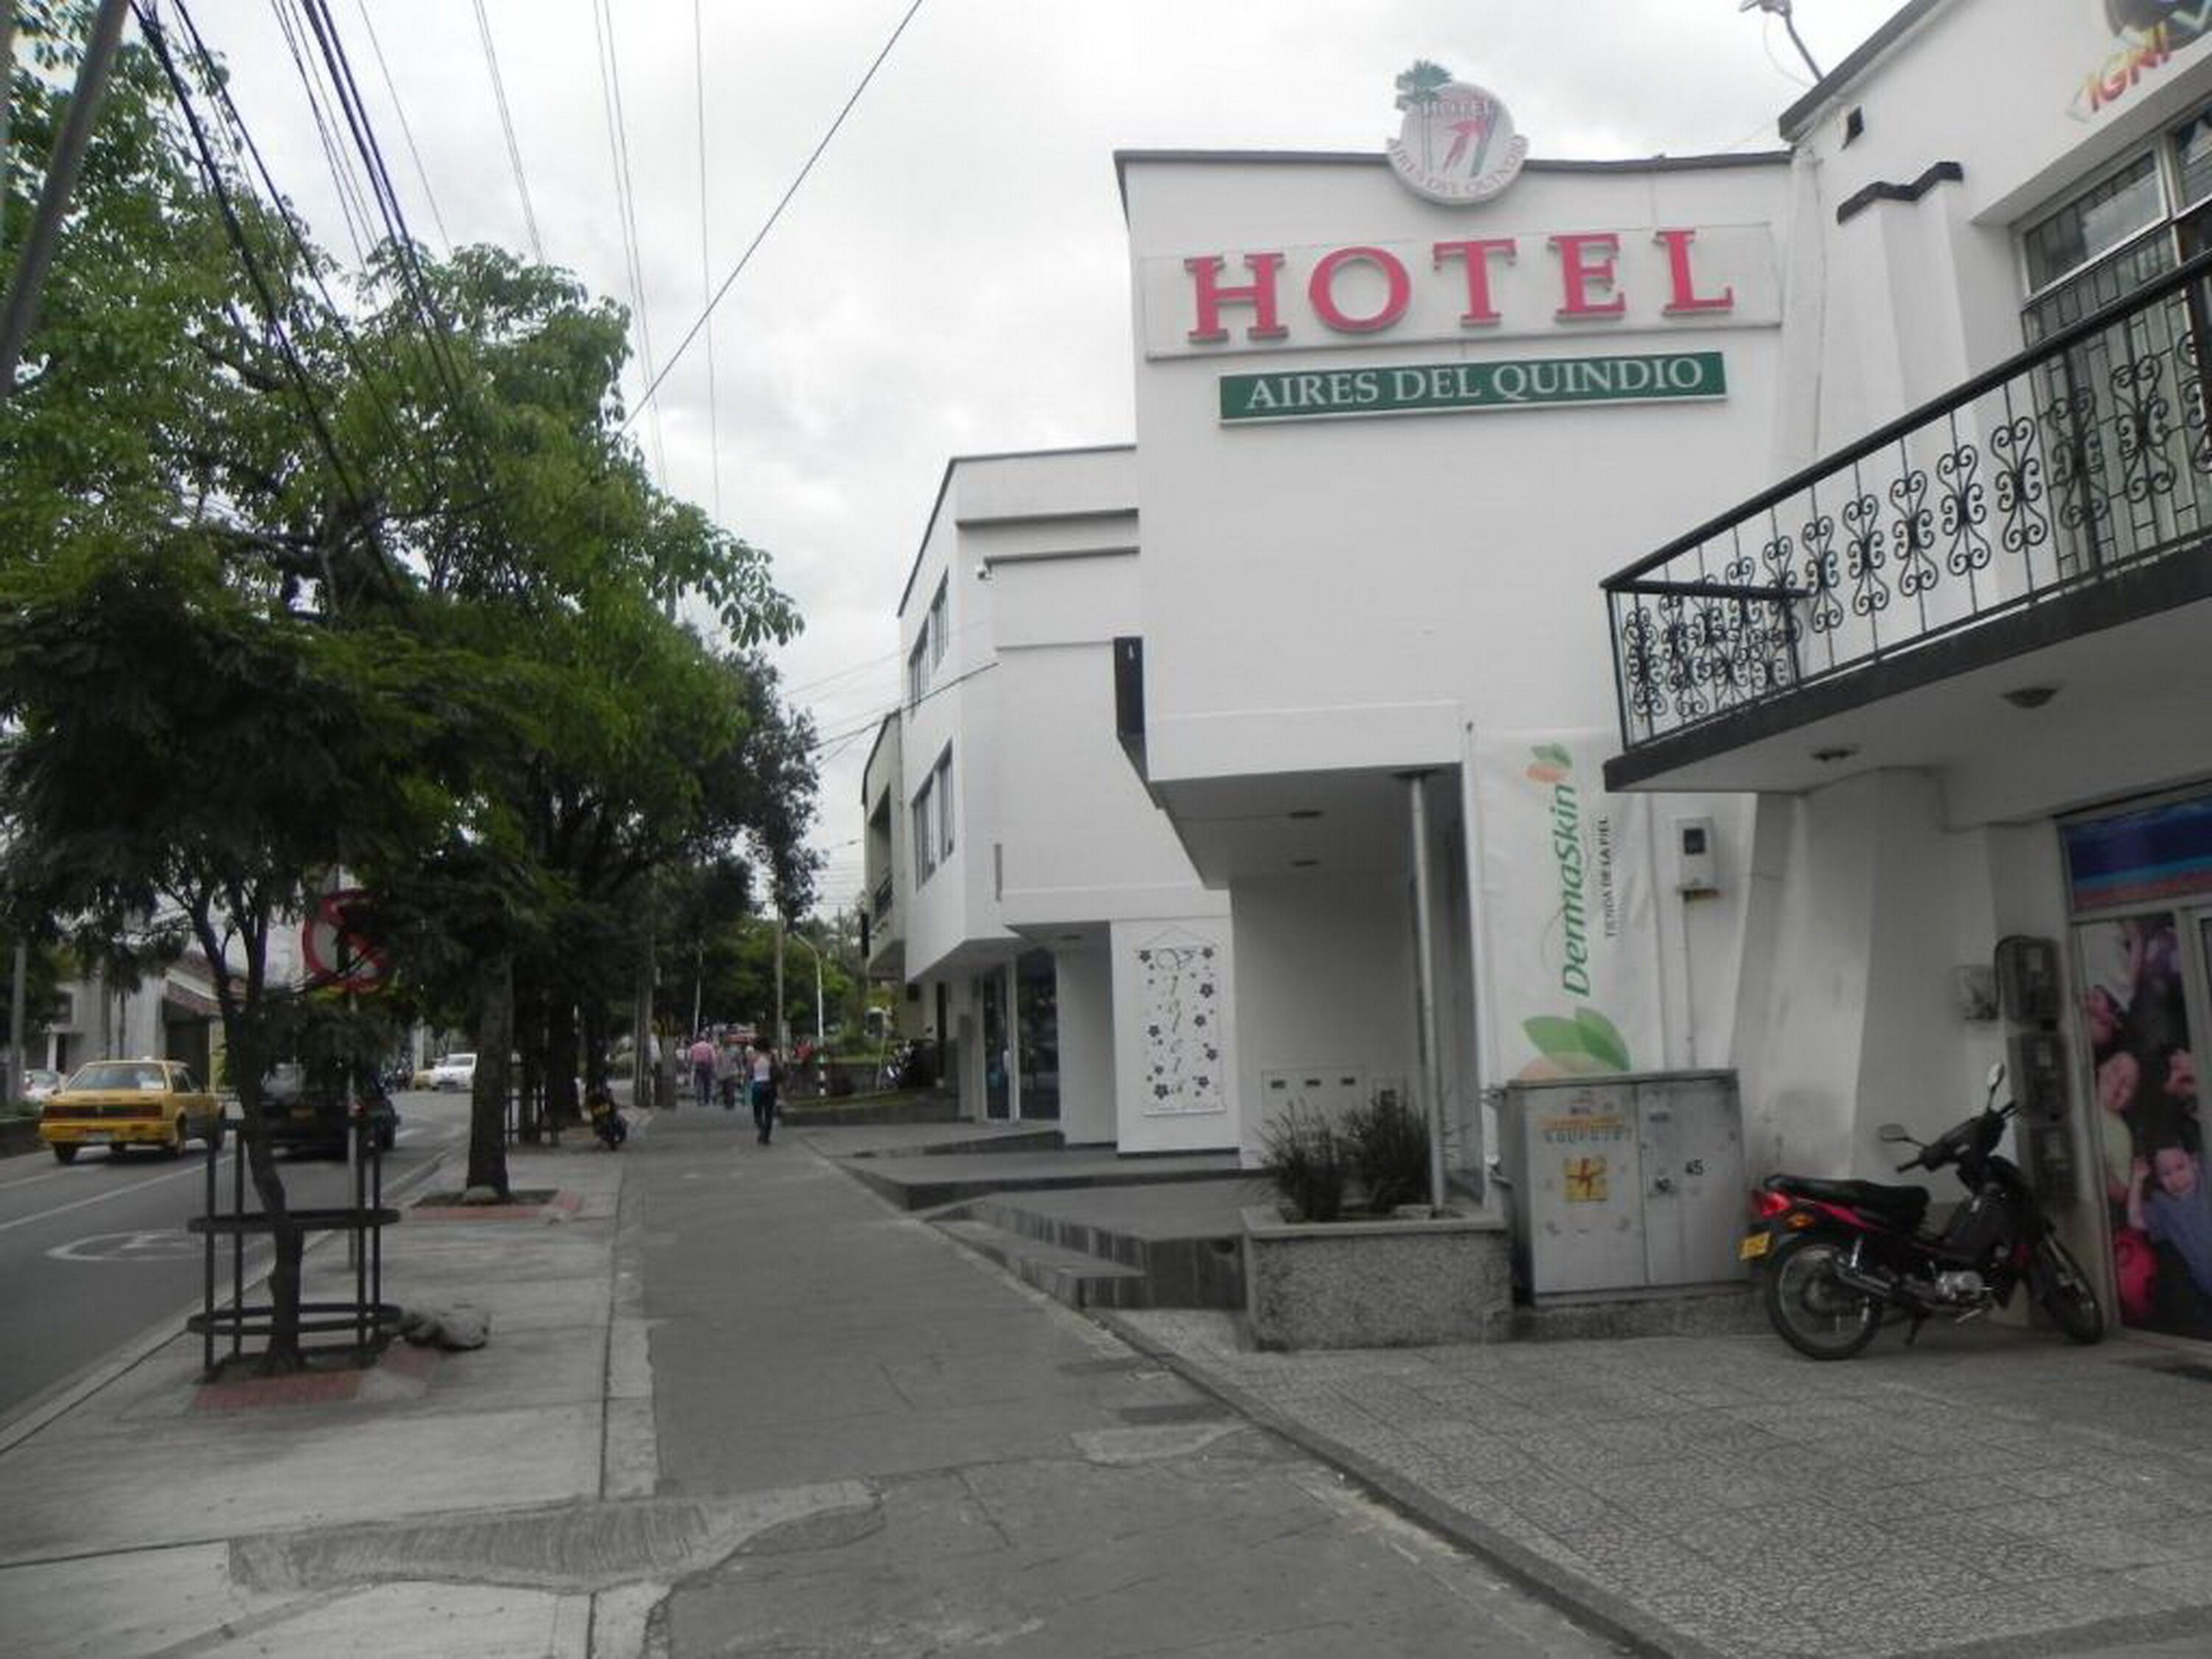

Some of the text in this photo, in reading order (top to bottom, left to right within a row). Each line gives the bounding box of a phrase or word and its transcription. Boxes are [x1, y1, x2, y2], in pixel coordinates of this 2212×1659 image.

[1183, 230, 1734, 344] HOTEL
[1245, 358, 1705, 409] AIRES DEL QUINDIO
[1550, 783, 1591, 998] DermaSkin
